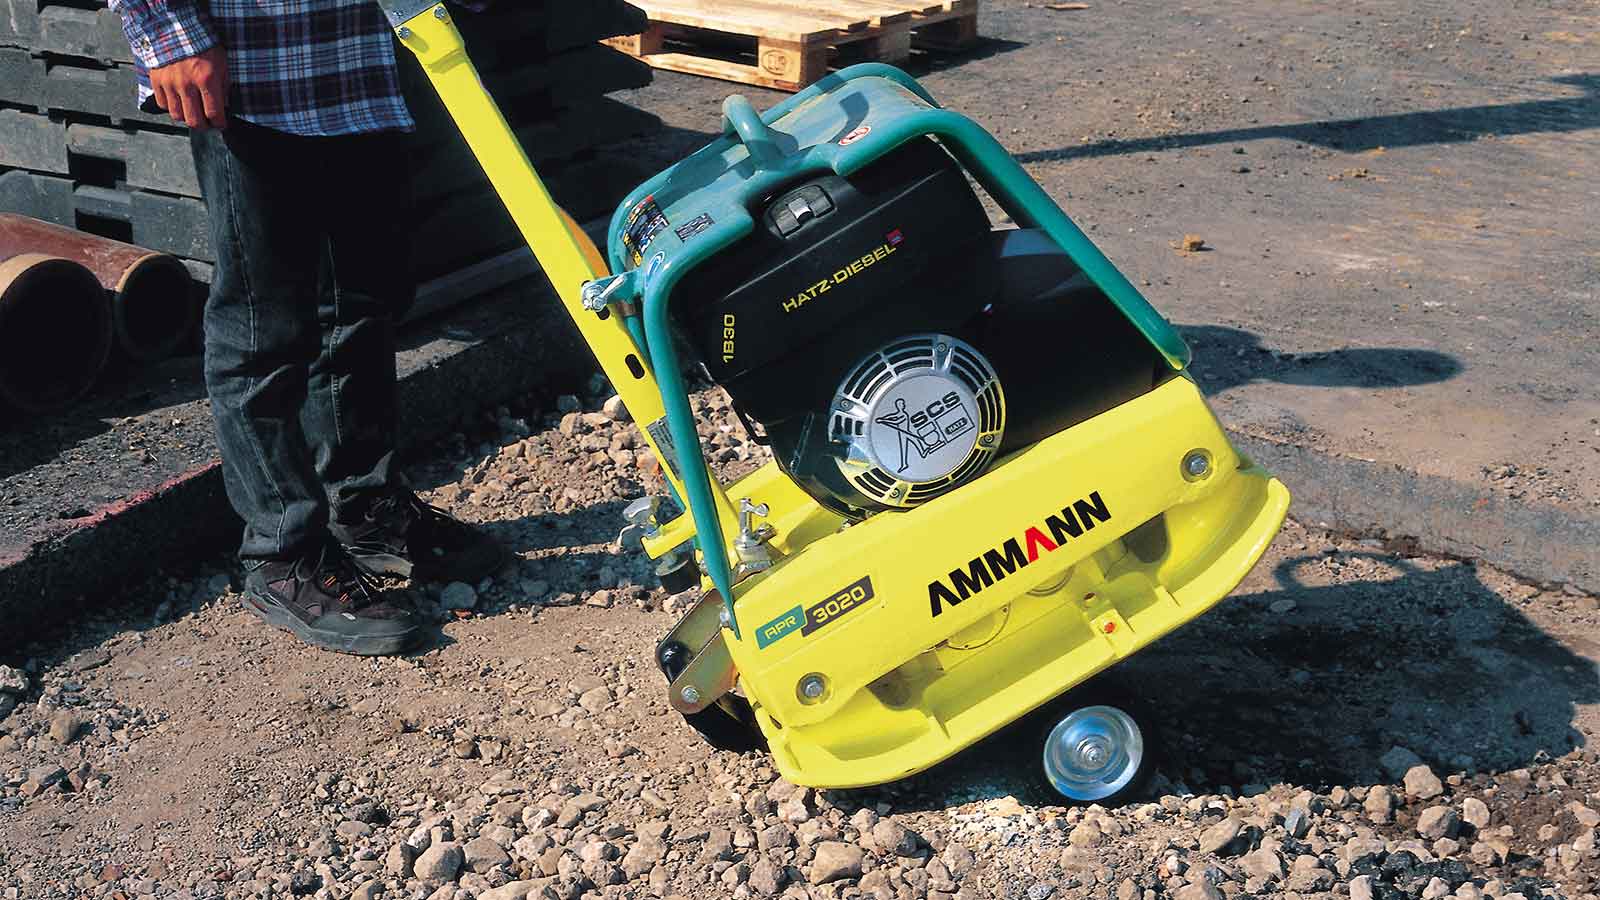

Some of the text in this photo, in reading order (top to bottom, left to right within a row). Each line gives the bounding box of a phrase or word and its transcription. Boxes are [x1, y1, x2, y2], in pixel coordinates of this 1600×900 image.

[782, 244, 897, 313] HATZ-DIESEL
[723, 314, 735, 363] 1B30
[910, 391, 961, 428] SCS
[928, 491, 1112, 618] AMMANN
[764, 585, 866, 640] APR 3020
